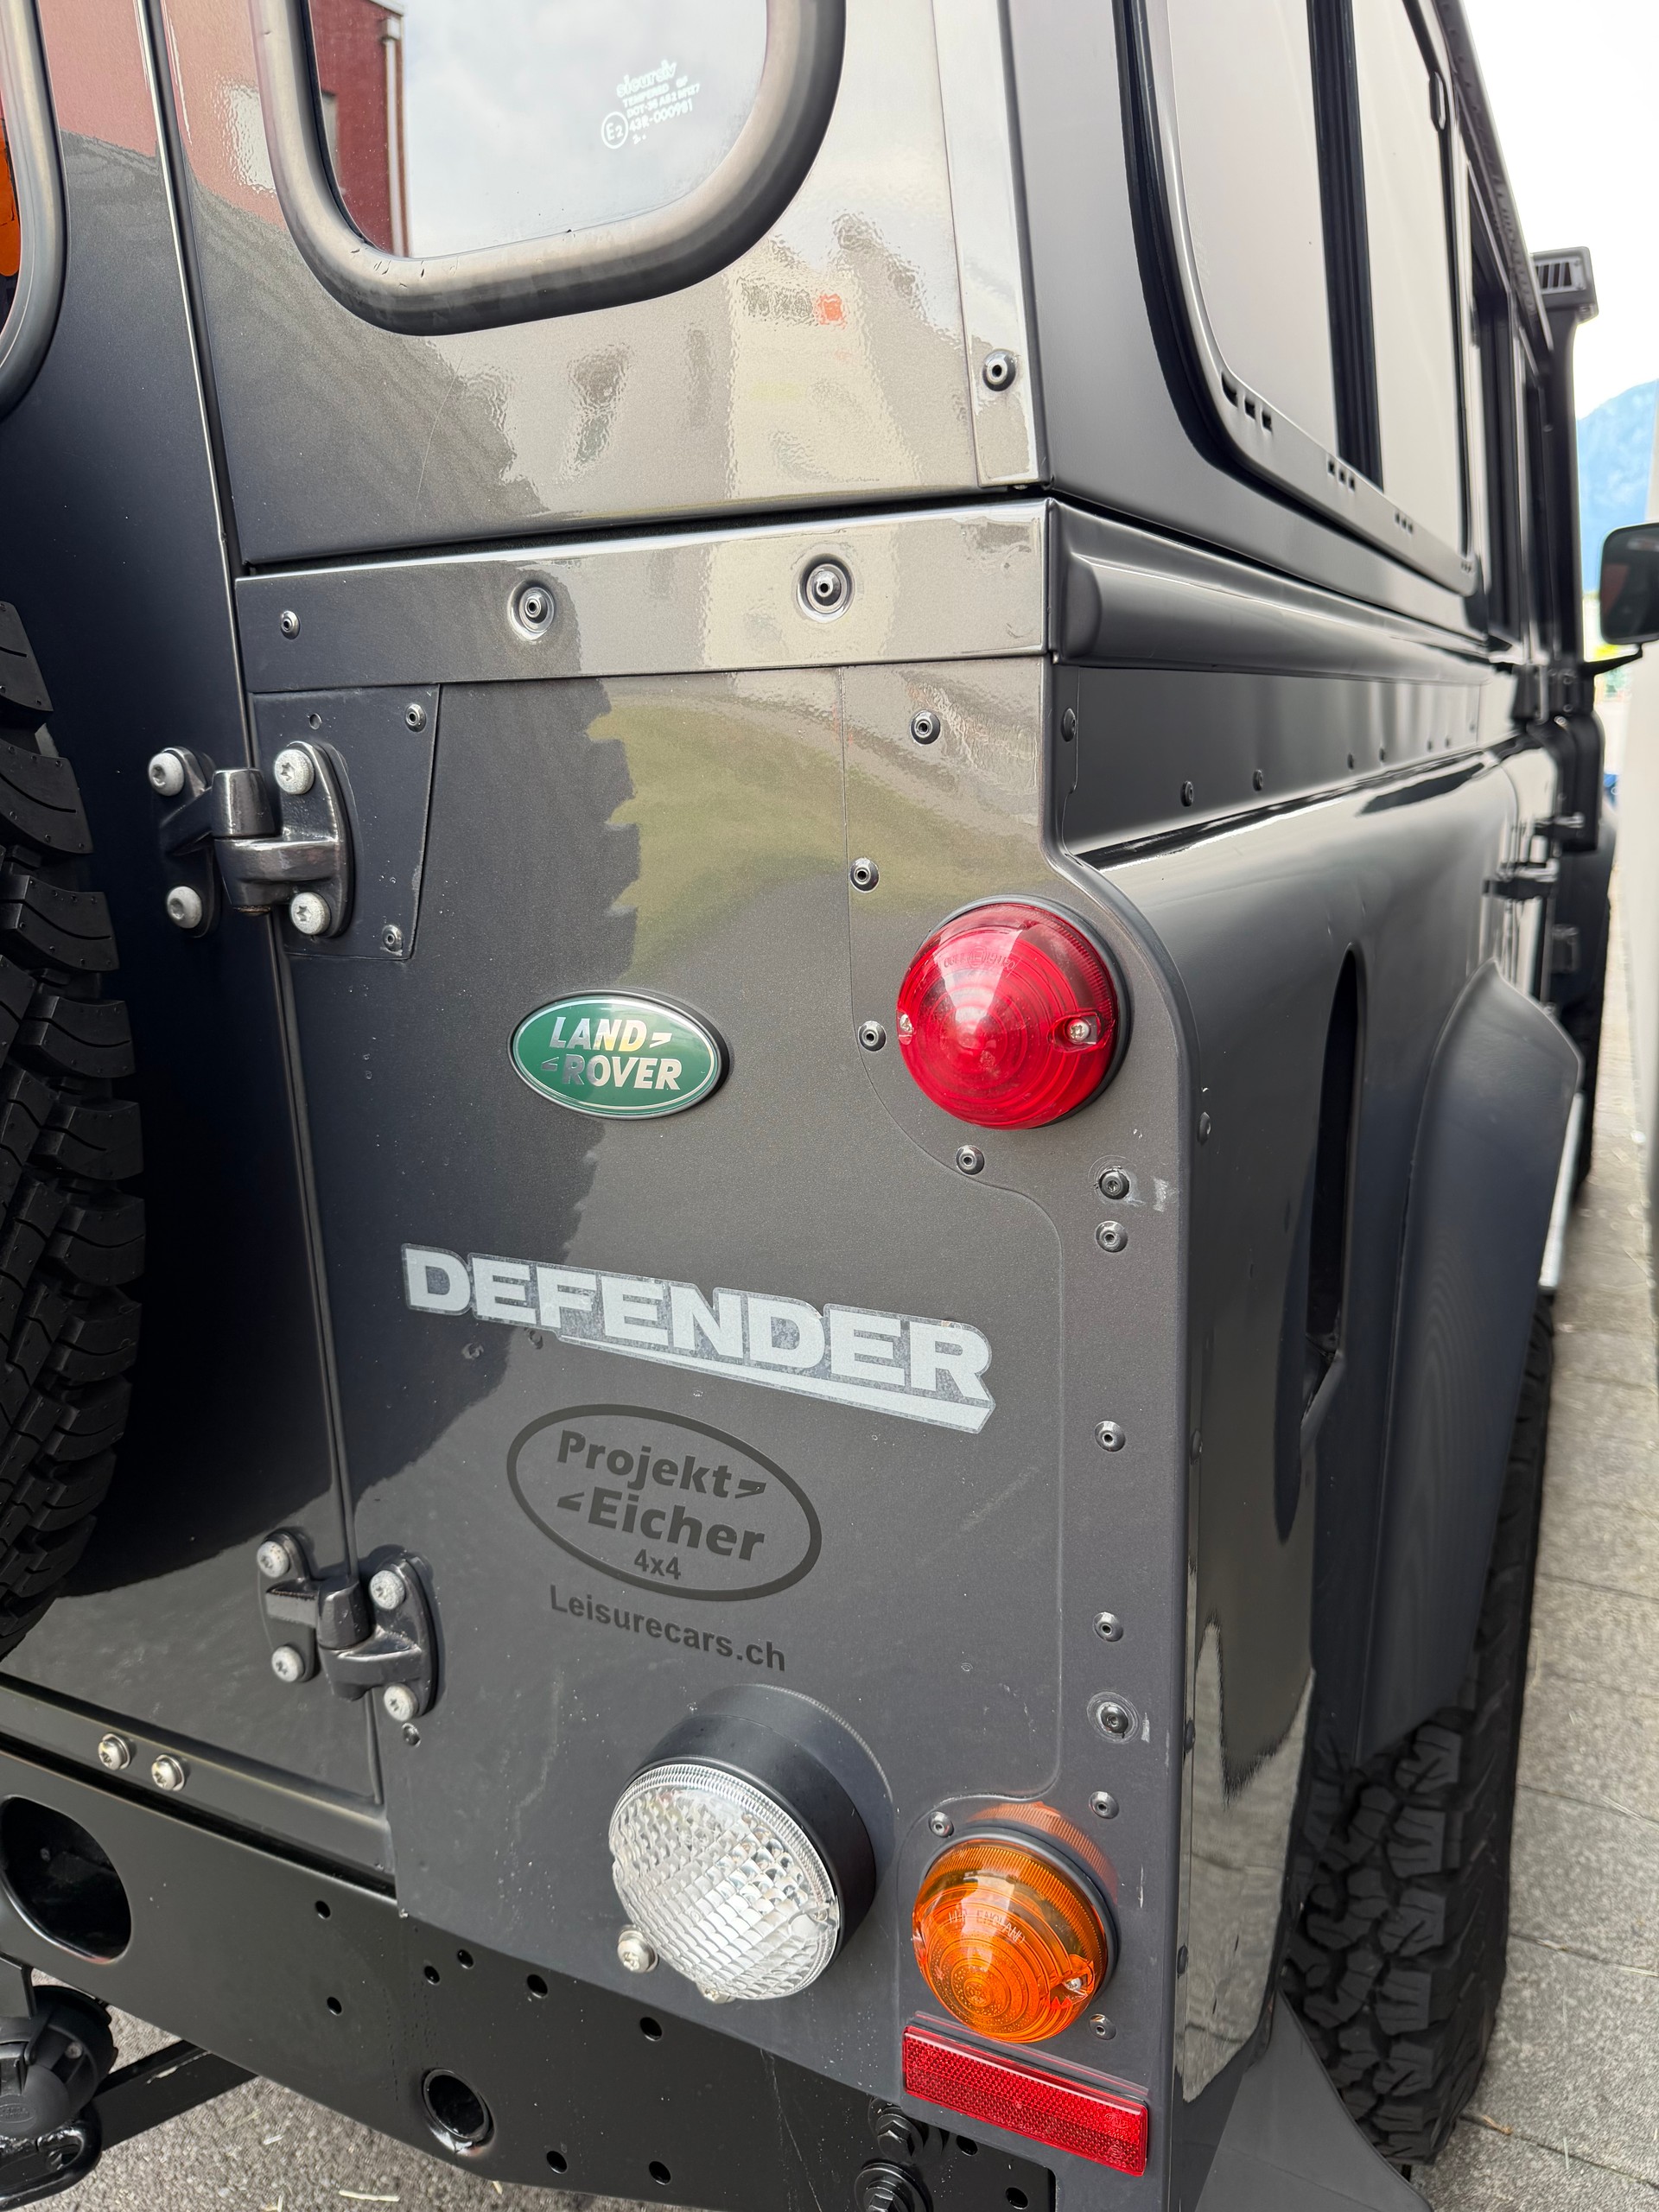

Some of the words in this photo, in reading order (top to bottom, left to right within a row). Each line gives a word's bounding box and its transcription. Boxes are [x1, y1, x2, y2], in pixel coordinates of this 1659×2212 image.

[549, 1016, 647, 1052] LAND
[562, 1053, 683, 1090] ROVER
[404, 1247, 993, 1402] DEFENDER
[556, 1429, 733, 1499] Projekt
[588, 1486, 766, 1561] Eicher
[633, 1548, 682, 1580] 4x4
[550, 1584, 785, 1672] Leisurecars.ch
